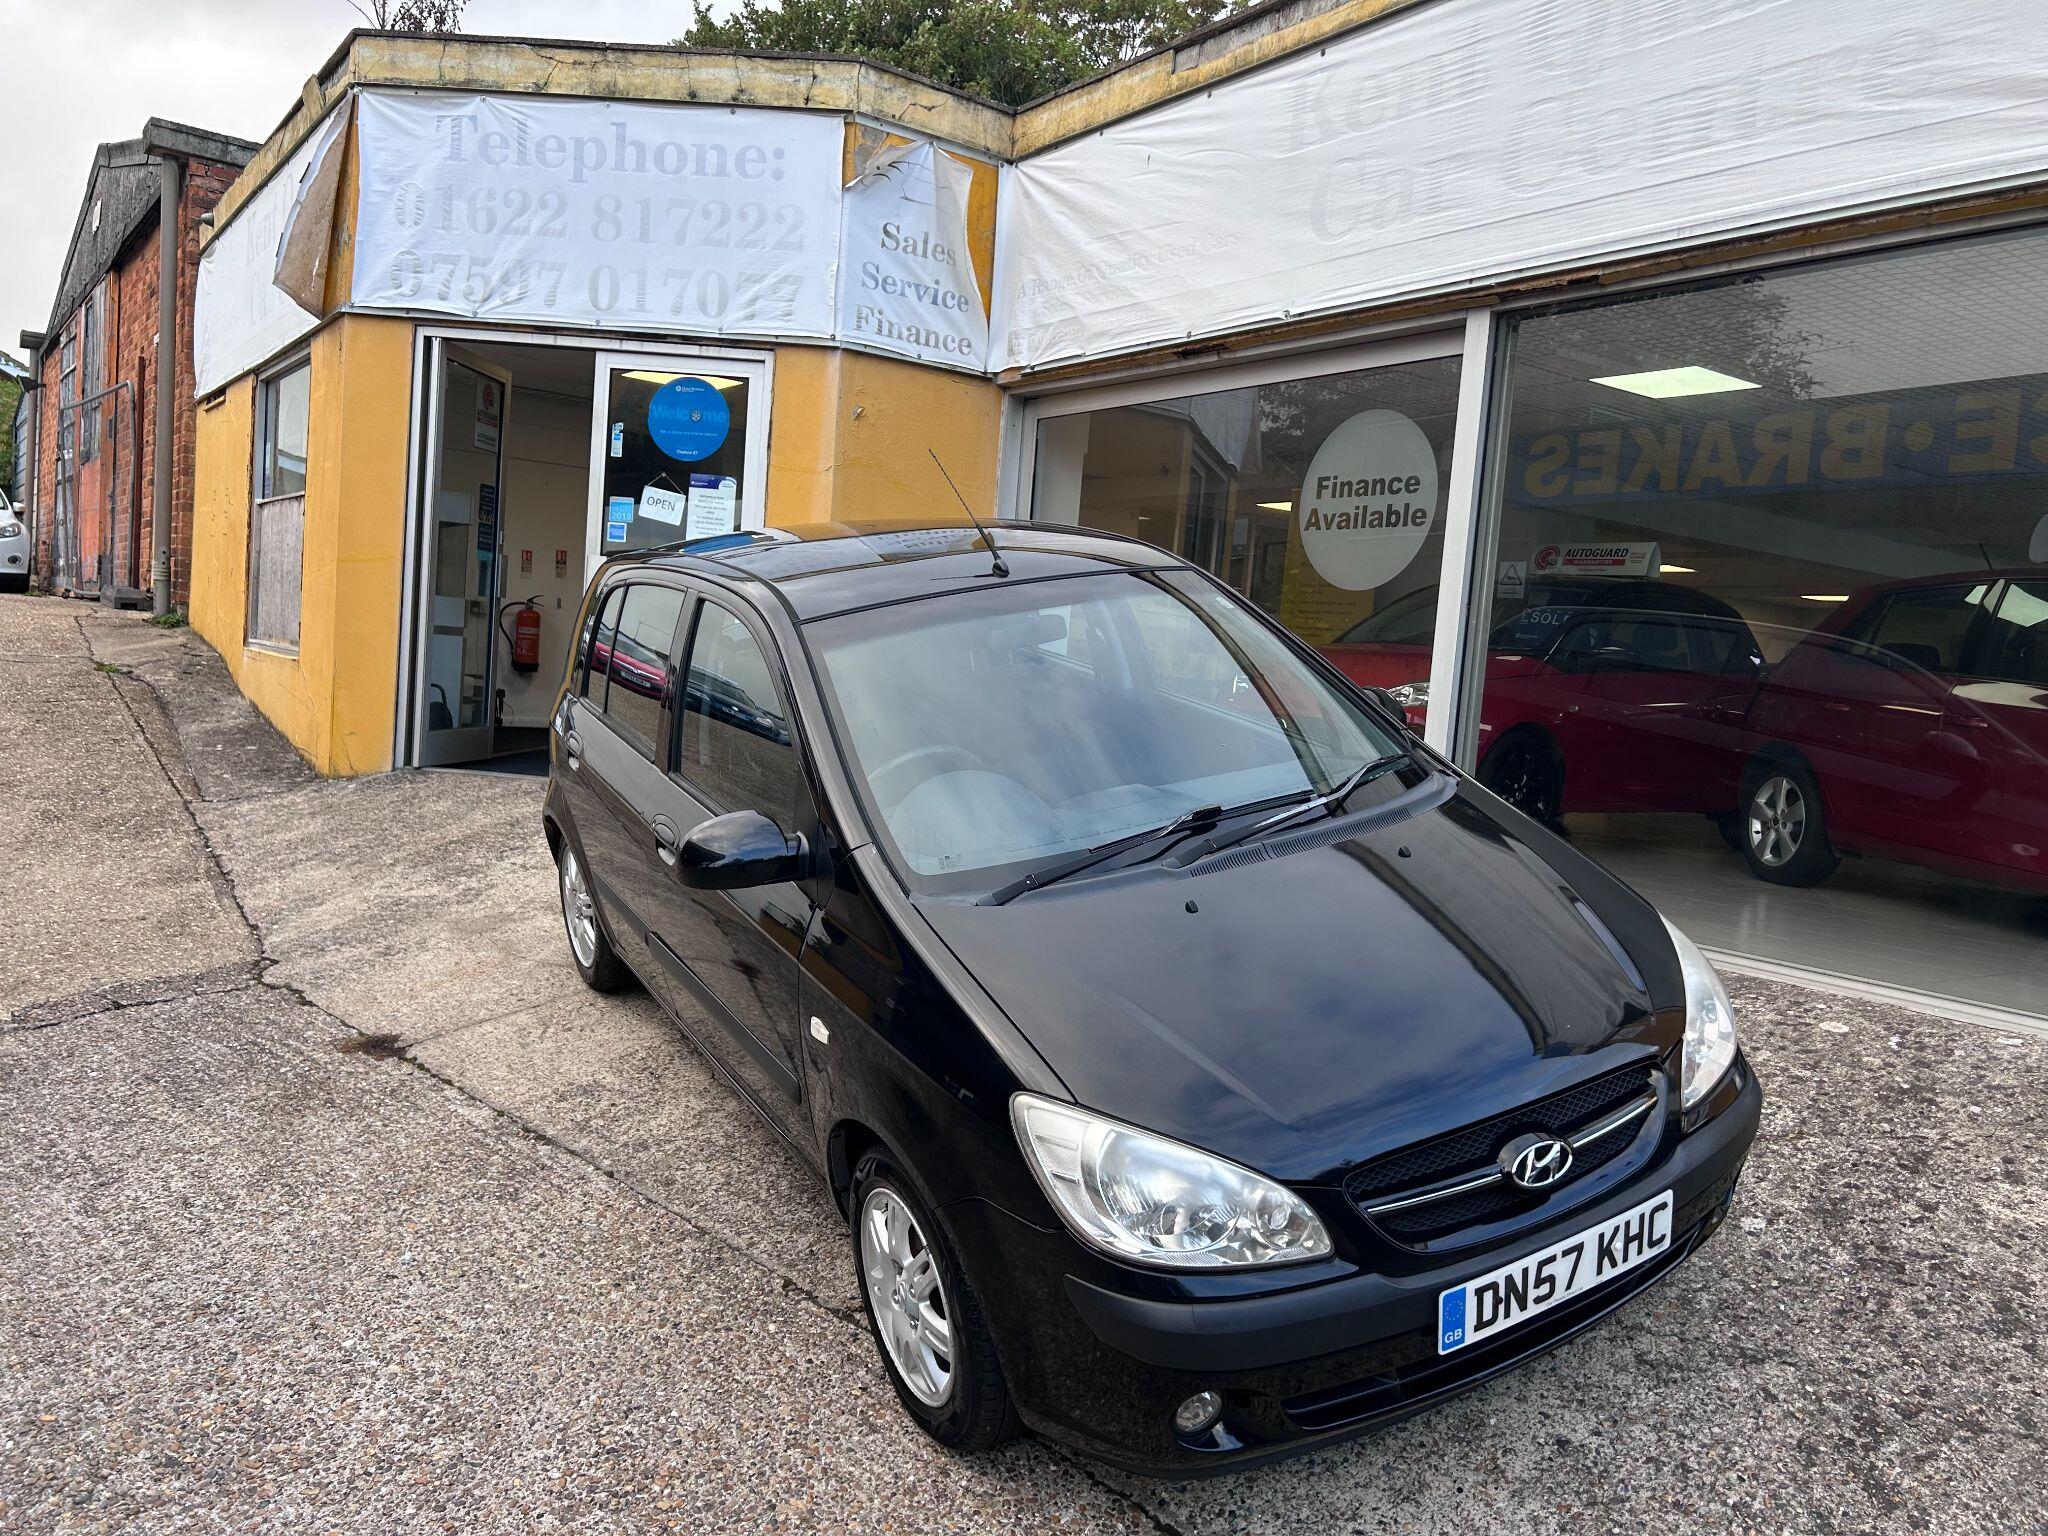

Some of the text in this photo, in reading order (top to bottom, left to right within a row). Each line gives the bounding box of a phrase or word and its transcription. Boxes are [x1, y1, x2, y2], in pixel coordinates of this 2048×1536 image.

[436, 114, 785, 184] Telephone:
[395, 182, 806, 251] 01622 817222
[880, 222, 957, 267] Sales
[391, 249, 804, 322] 07597 017077
[861, 261, 971, 313] Service
[853, 303, 973, 356] Finance
[646, 496, 676, 512] OPEN
[1315, 474, 1421, 500] Finance
[1303, 502, 1428, 532] Available
[1564, 548, 1629, 558] AUTOGUARD
[1473, 1201, 1669, 1333] DN57 KHC
[1444, 1328, 1463, 1344] GB
